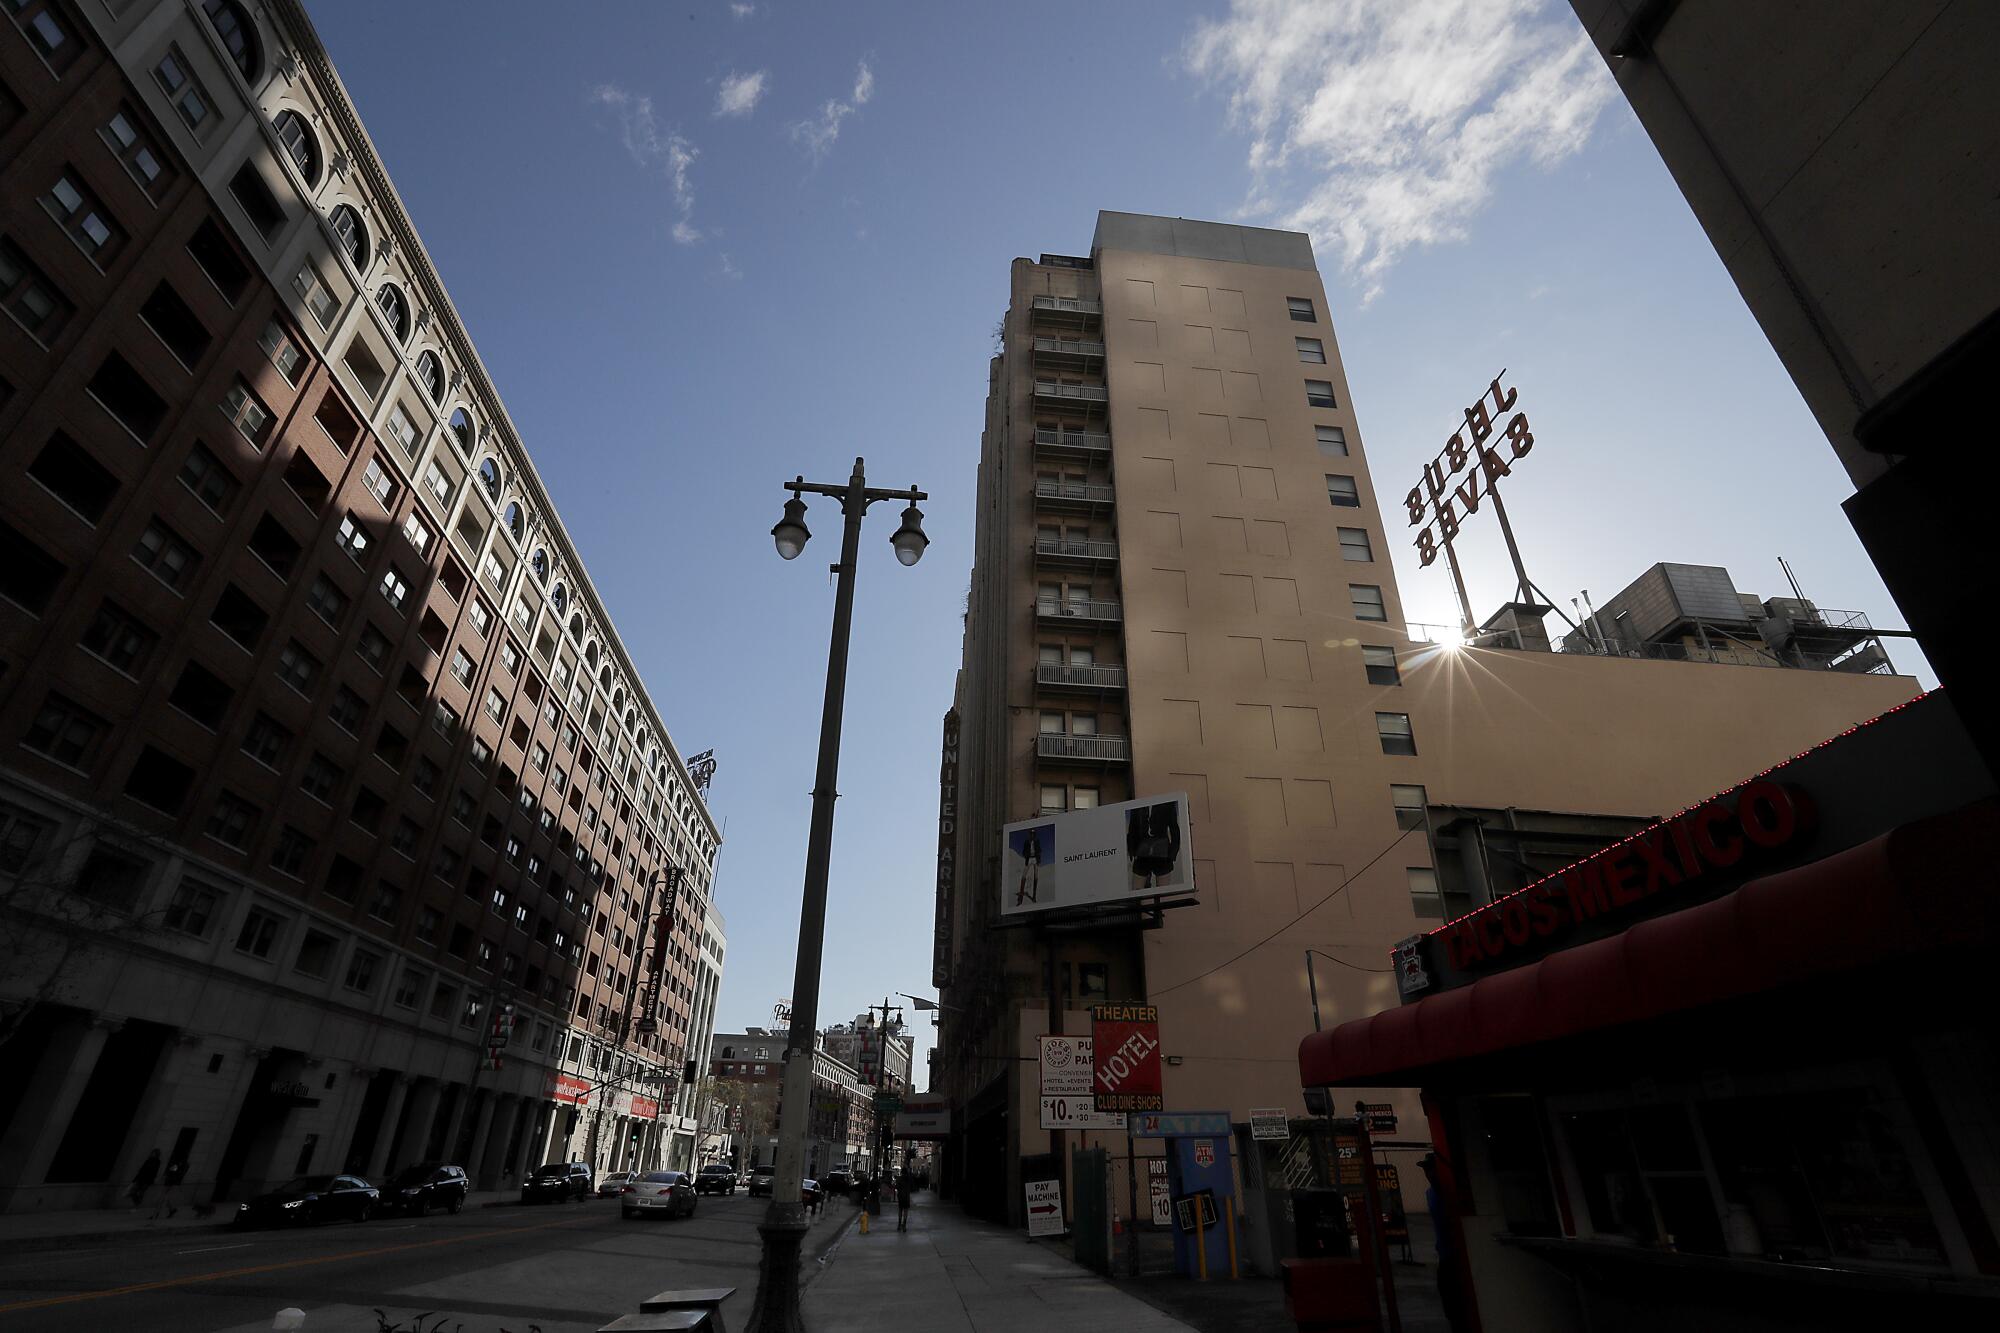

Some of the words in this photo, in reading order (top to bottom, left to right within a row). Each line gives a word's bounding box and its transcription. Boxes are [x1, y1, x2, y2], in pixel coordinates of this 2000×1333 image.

[940, 734, 958, 836] UNITED
[1063, 853, 1083, 863] SAINT
[1084, 848, 1117, 860] LAURENT
[1441, 888, 1564, 970] TACOS
[1564, 781, 1800, 926] MEXICO
[664, 869, 678, 916] BROADWAY
[934, 847, 953, 982] ARTISTS
[1095, 1006, 1157, 1020] THEATER
[1047, 1040, 1069, 1052] JOE'S
[1078, 1041, 1092, 1050] PU
[1075, 1055, 1095, 1065] PAR
[1096, 1031, 1158, 1092] HOTEL
[1097, 1096, 1118, 1110] CLUB
[1149, 1160, 1168, 1174] HOT
[1376, 1167, 1397, 1179] LIC
[1034, 1183, 1049, 1192] PAY
[1028, 1192, 1059, 1203] MACHINE
